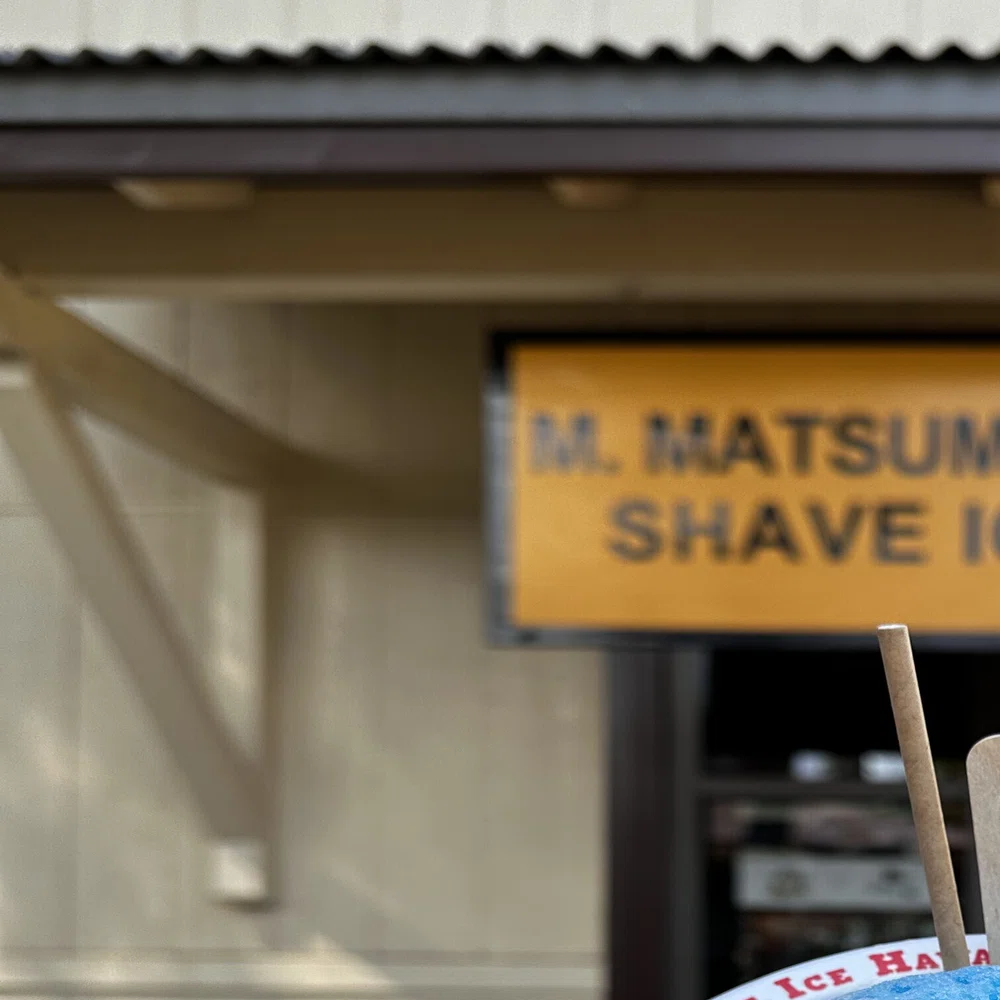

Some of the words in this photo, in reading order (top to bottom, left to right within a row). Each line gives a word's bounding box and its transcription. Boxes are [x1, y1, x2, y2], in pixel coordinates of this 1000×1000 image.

[530, 409, 622, 476] M.
[606, 496, 928, 566] SHAVE
[774, 968, 853, 1000] ICE
[869, 948, 992, 976] HAA
